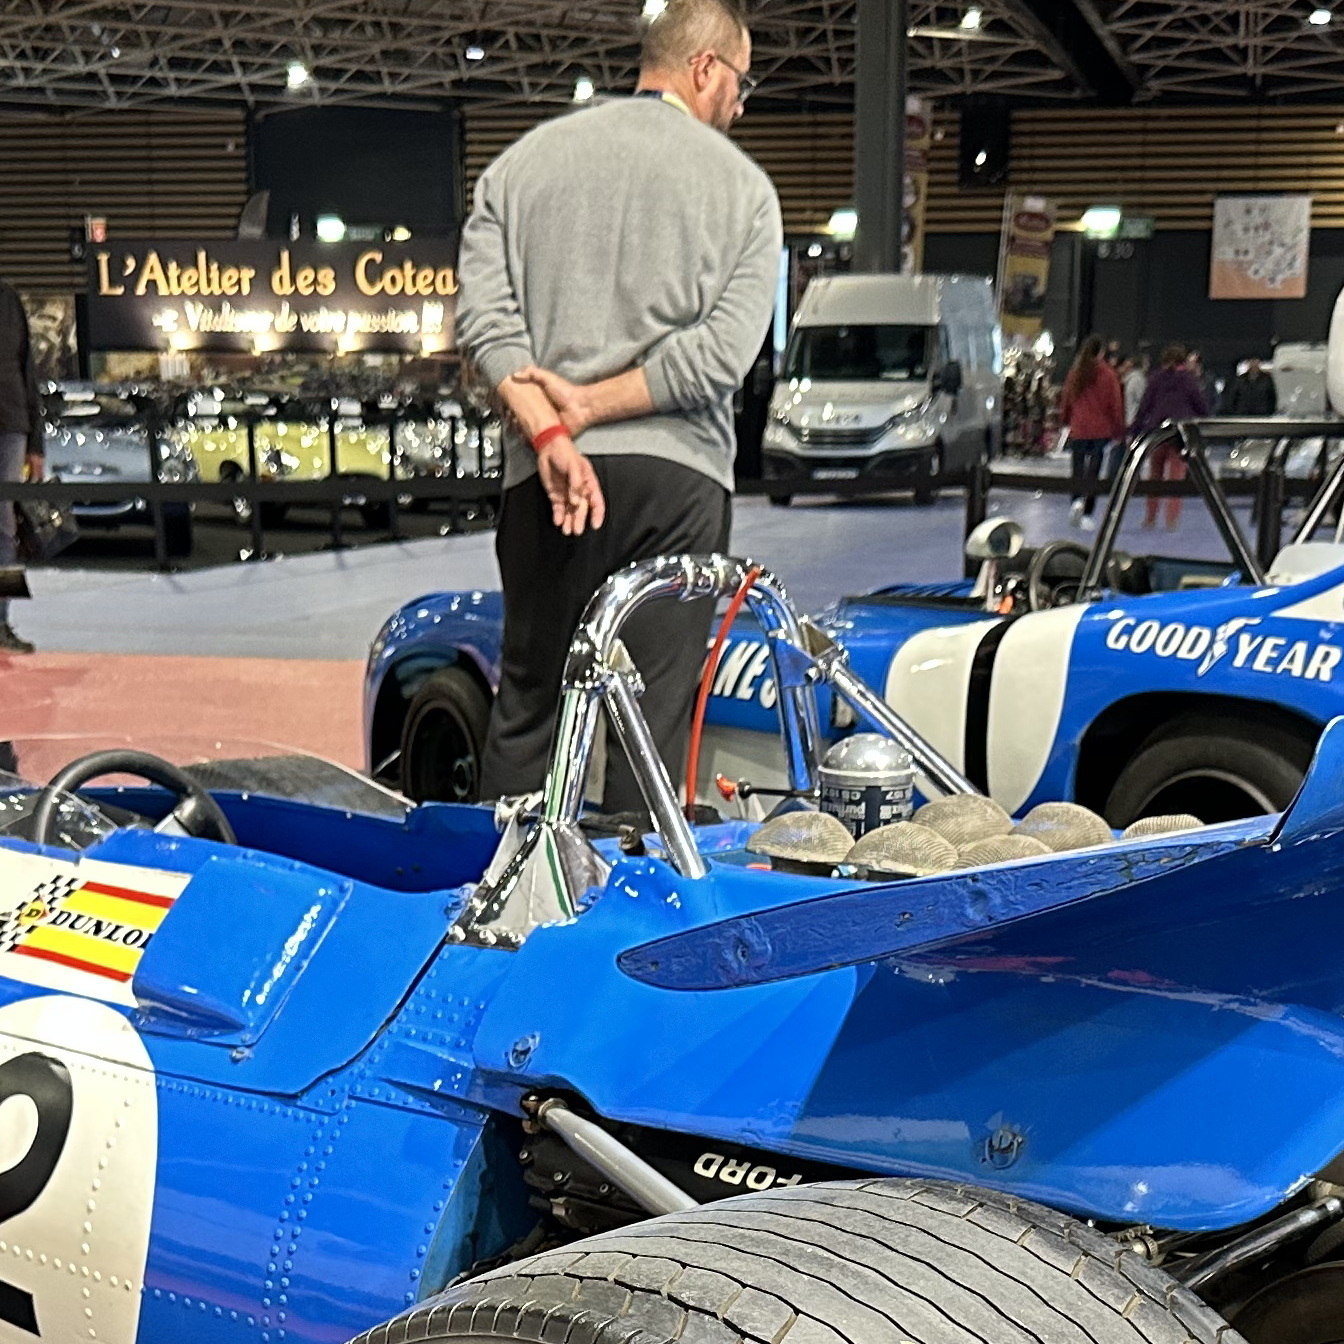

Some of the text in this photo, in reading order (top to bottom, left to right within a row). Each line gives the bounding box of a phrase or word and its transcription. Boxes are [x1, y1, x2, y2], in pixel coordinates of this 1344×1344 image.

[96, 247, 459, 297] L'Atelier des Cotea
